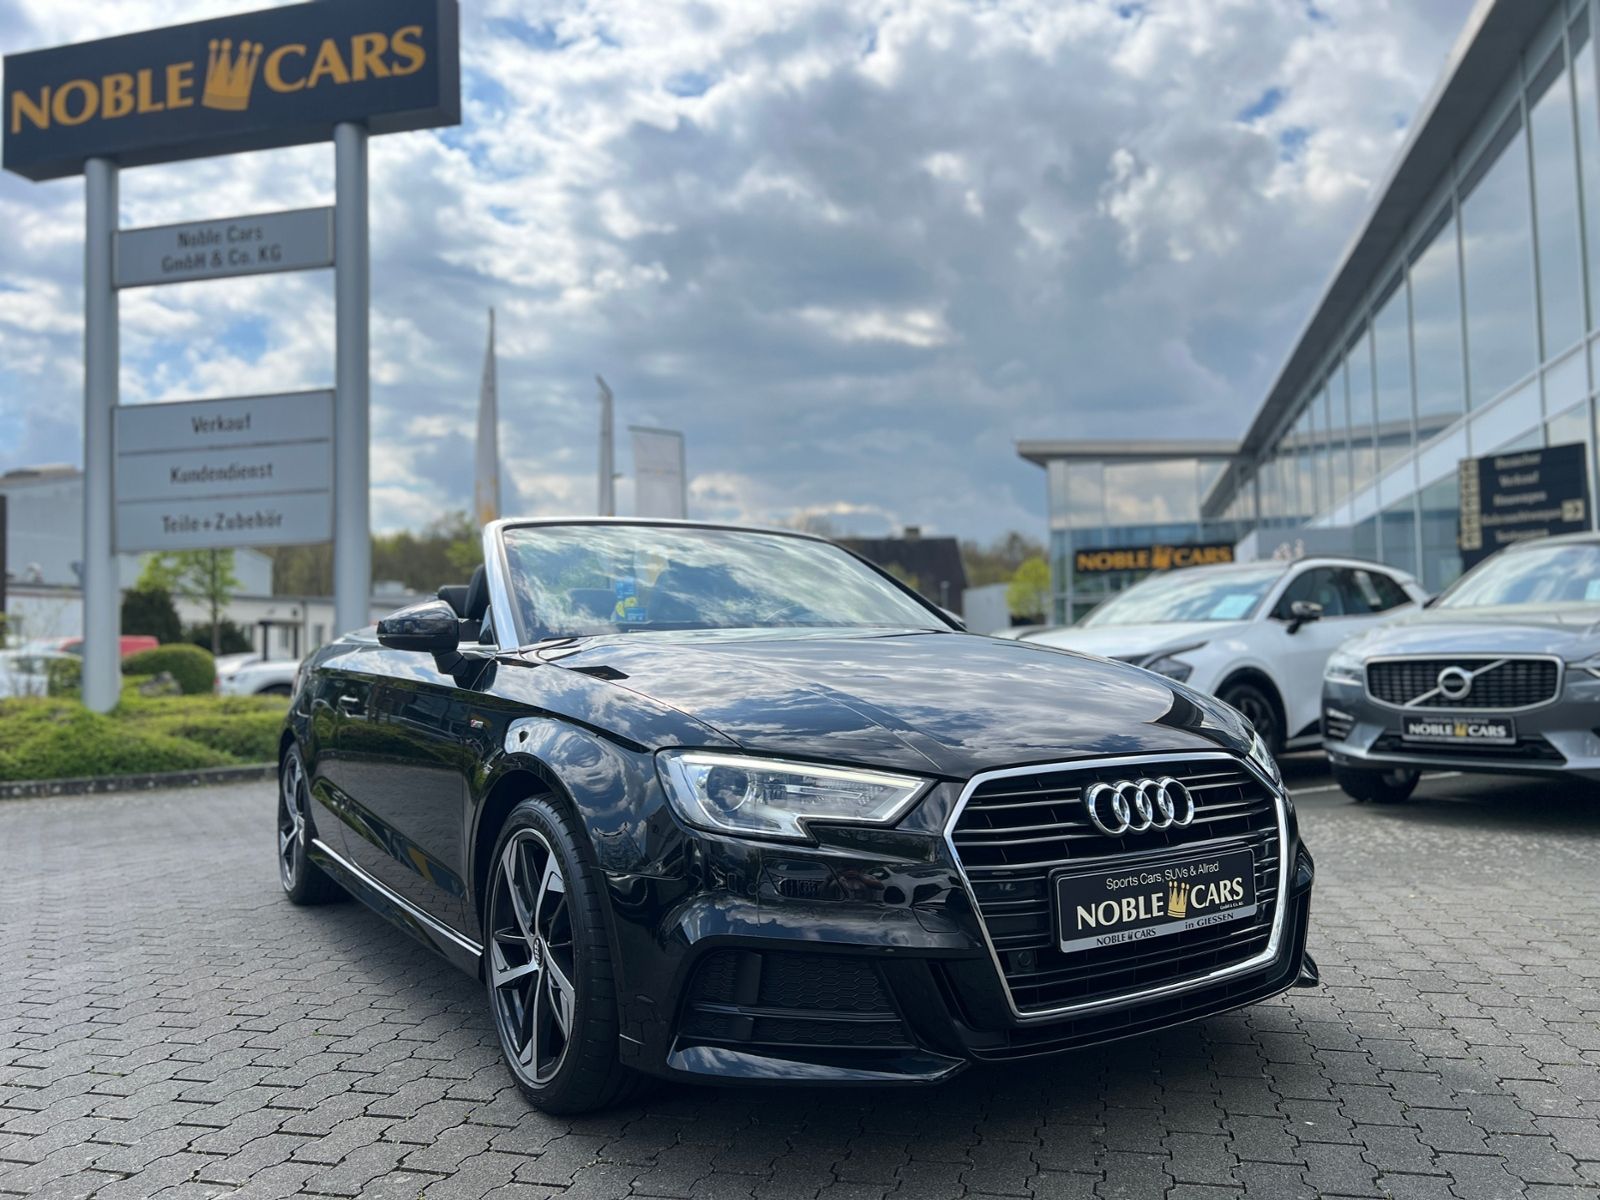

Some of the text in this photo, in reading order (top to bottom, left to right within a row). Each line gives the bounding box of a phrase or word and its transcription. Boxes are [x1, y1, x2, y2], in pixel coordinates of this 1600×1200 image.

[11, 25, 426, 134] NOBLE CARS
[177, 225, 263, 248] Noble Cars
[161, 244, 282, 273] GmbH & Co. KG
[192, 413, 251, 433] Verkauf
[170, 462, 273, 484] Kundendienst
[1077, 546, 1232, 570] NOBLE CARS
[1408, 724, 1506, 737] NOBLE CARS
[1106, 861, 1219, 891] Sports Cars, SUVs & Allrad
[1076, 877, 1244, 930] NOBLE CARS
[1185, 912, 1234, 929] in GIESSEN
[1096, 928, 1156, 946] NOBLE CARS
